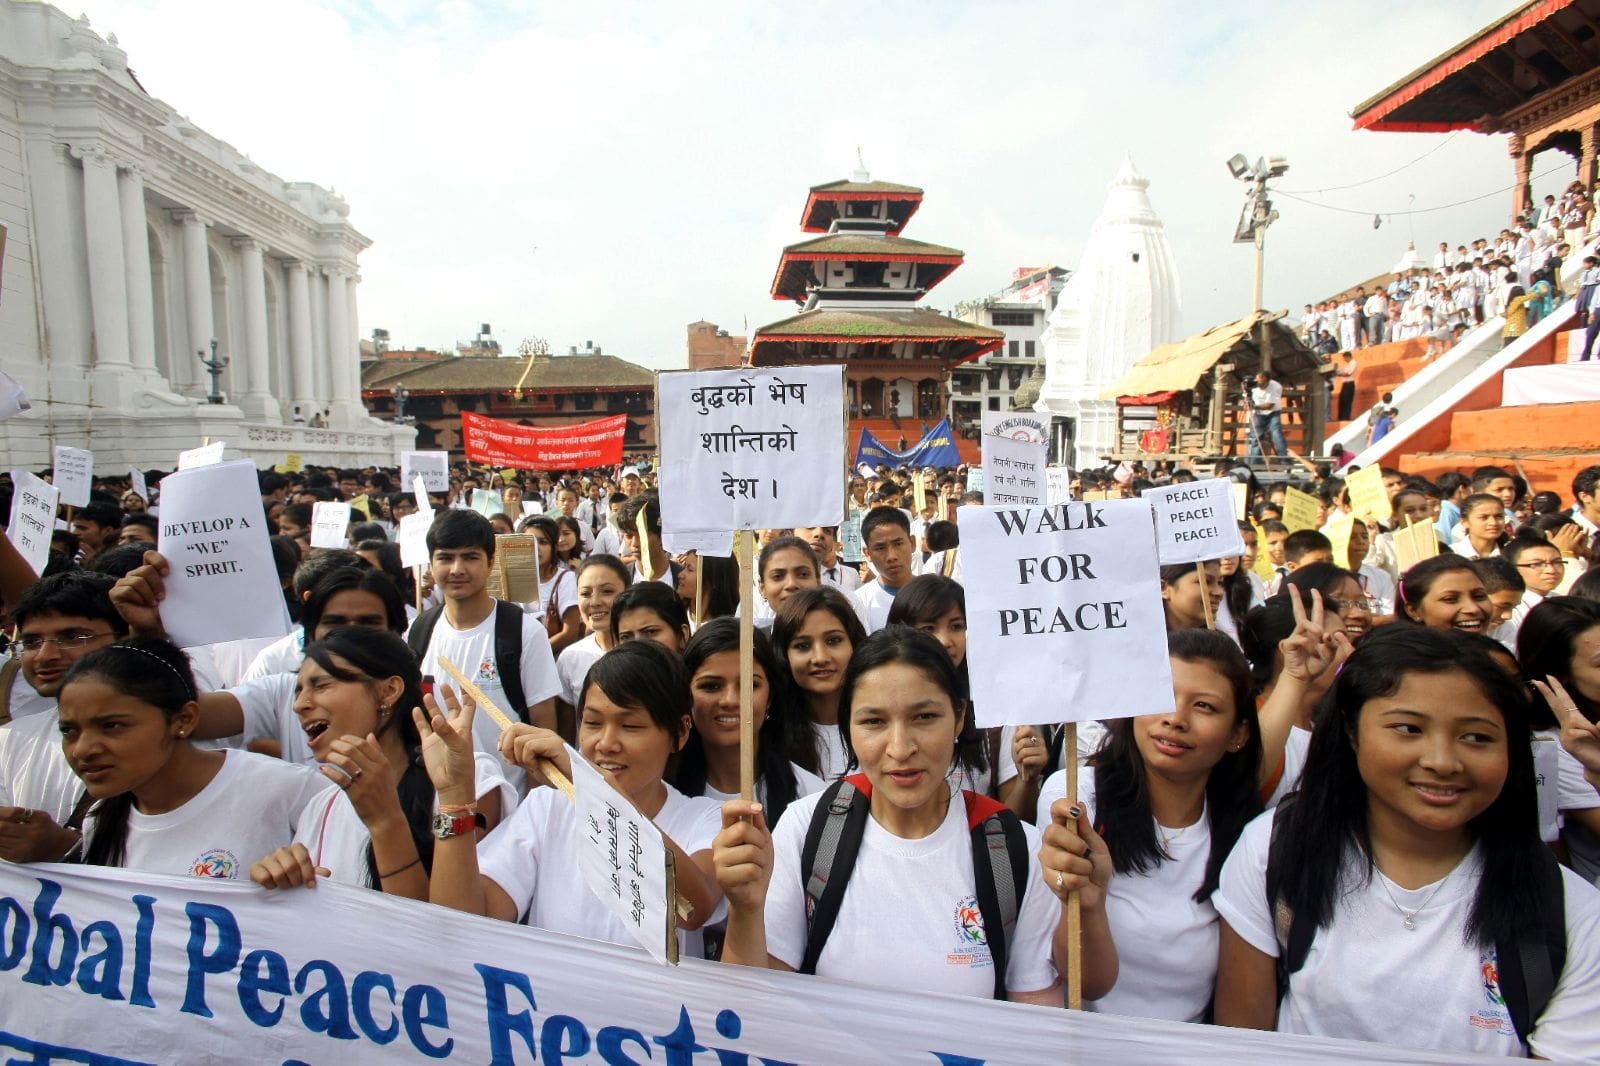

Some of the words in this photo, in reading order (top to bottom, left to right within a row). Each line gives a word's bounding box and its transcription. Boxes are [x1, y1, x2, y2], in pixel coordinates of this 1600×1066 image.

[690, 378, 755, 415] बुद्धको
[769, 377, 808, 405] भेष
[701, 424, 798, 454] शान्तिको
[721, 472, 759, 499] देश
[1166, 487, 1209, 504] PEACE!
[164, 517, 234, 538] DEVELOP
[239, 517, 250, 529] A
[1170, 507, 1214, 523] PEACE!
[1174, 526, 1218, 543] PEACE!
[185, 561, 243, 578] SPIRIT.
[1017, 553, 1097, 584] FOR
[998, 601, 1127, 636] PEACE
[179, 901, 454, 1059] Peace
